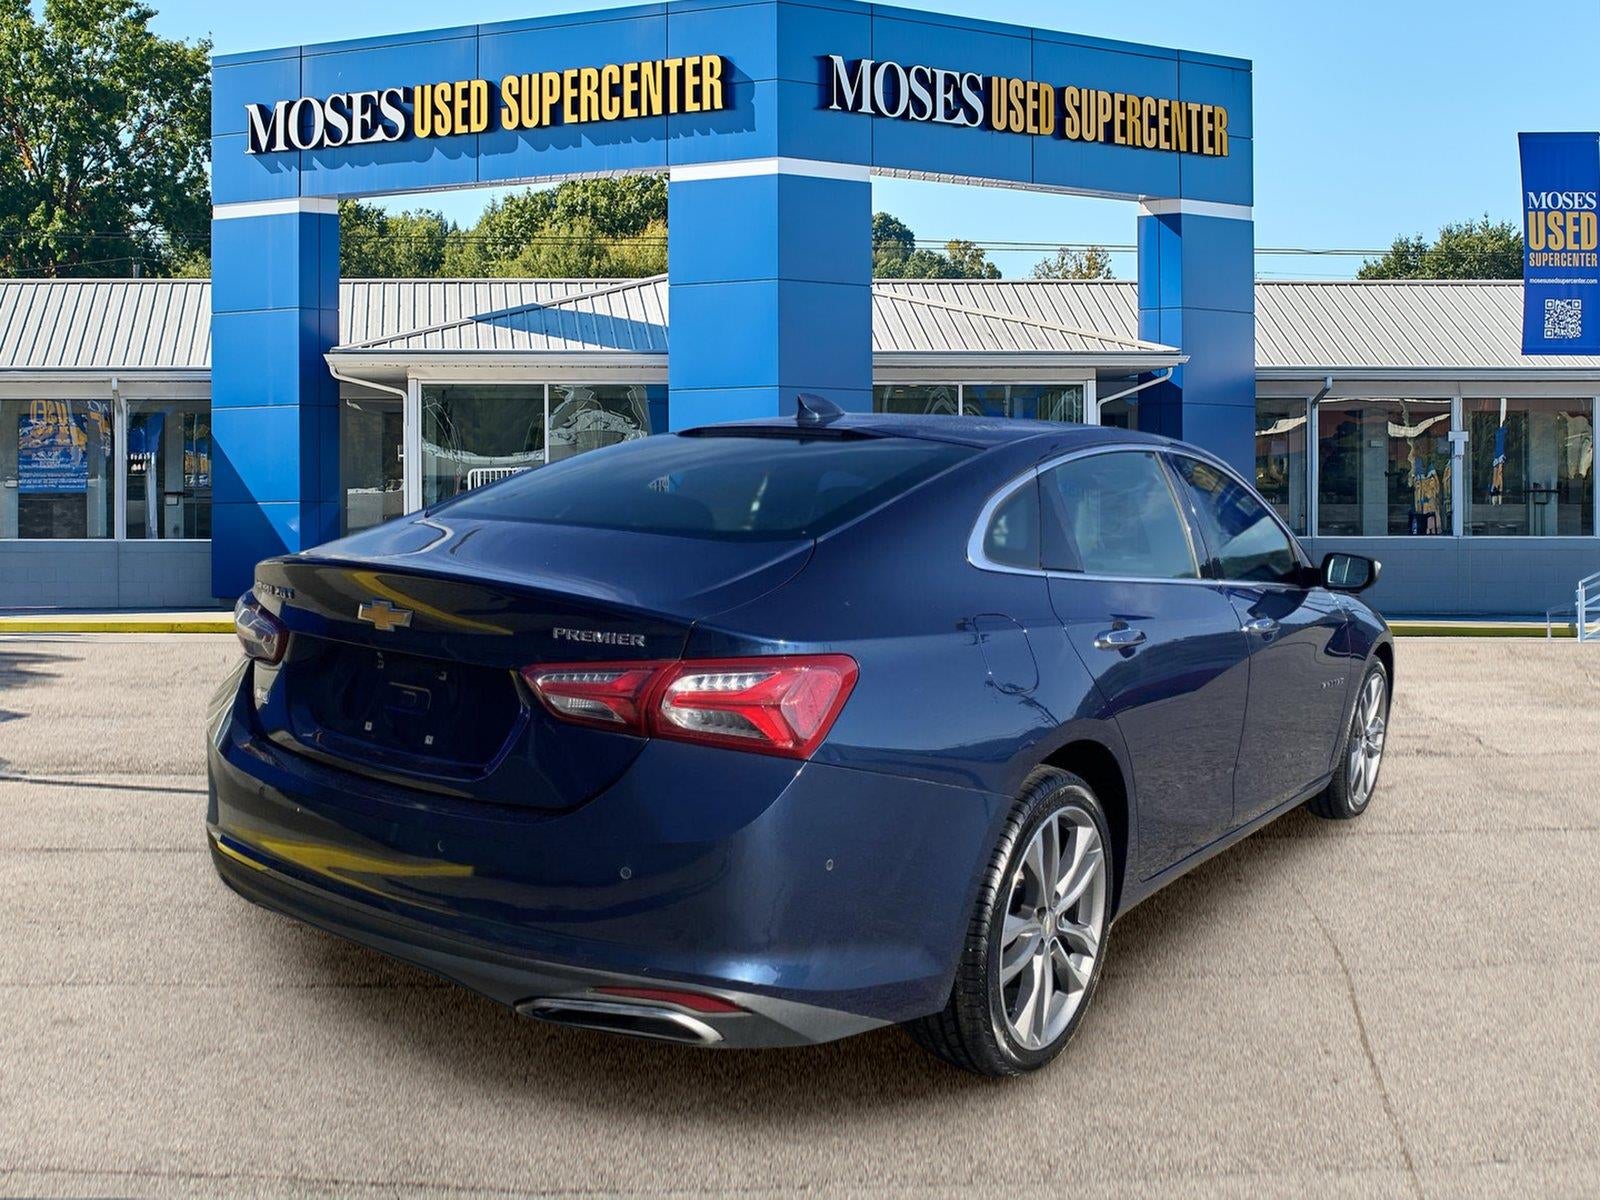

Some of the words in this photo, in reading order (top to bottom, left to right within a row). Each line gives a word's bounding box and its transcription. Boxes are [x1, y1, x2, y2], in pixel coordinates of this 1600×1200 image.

[244, 88, 406, 154] MOSES
[413, 79, 489, 139] USED
[500, 54, 724, 131] SUPERCENTER
[828, 54, 984, 128] MOSES
[991, 76, 1056, 136] USED
[1065, 86, 1230, 157] SUPERCENTER
[1527, 191, 1597, 210] MOSES
[1528, 211, 1598, 251] USED
[1529, 252, 1598, 268] SUPERCENTER
[552, 627, 645, 647] PREMIER
